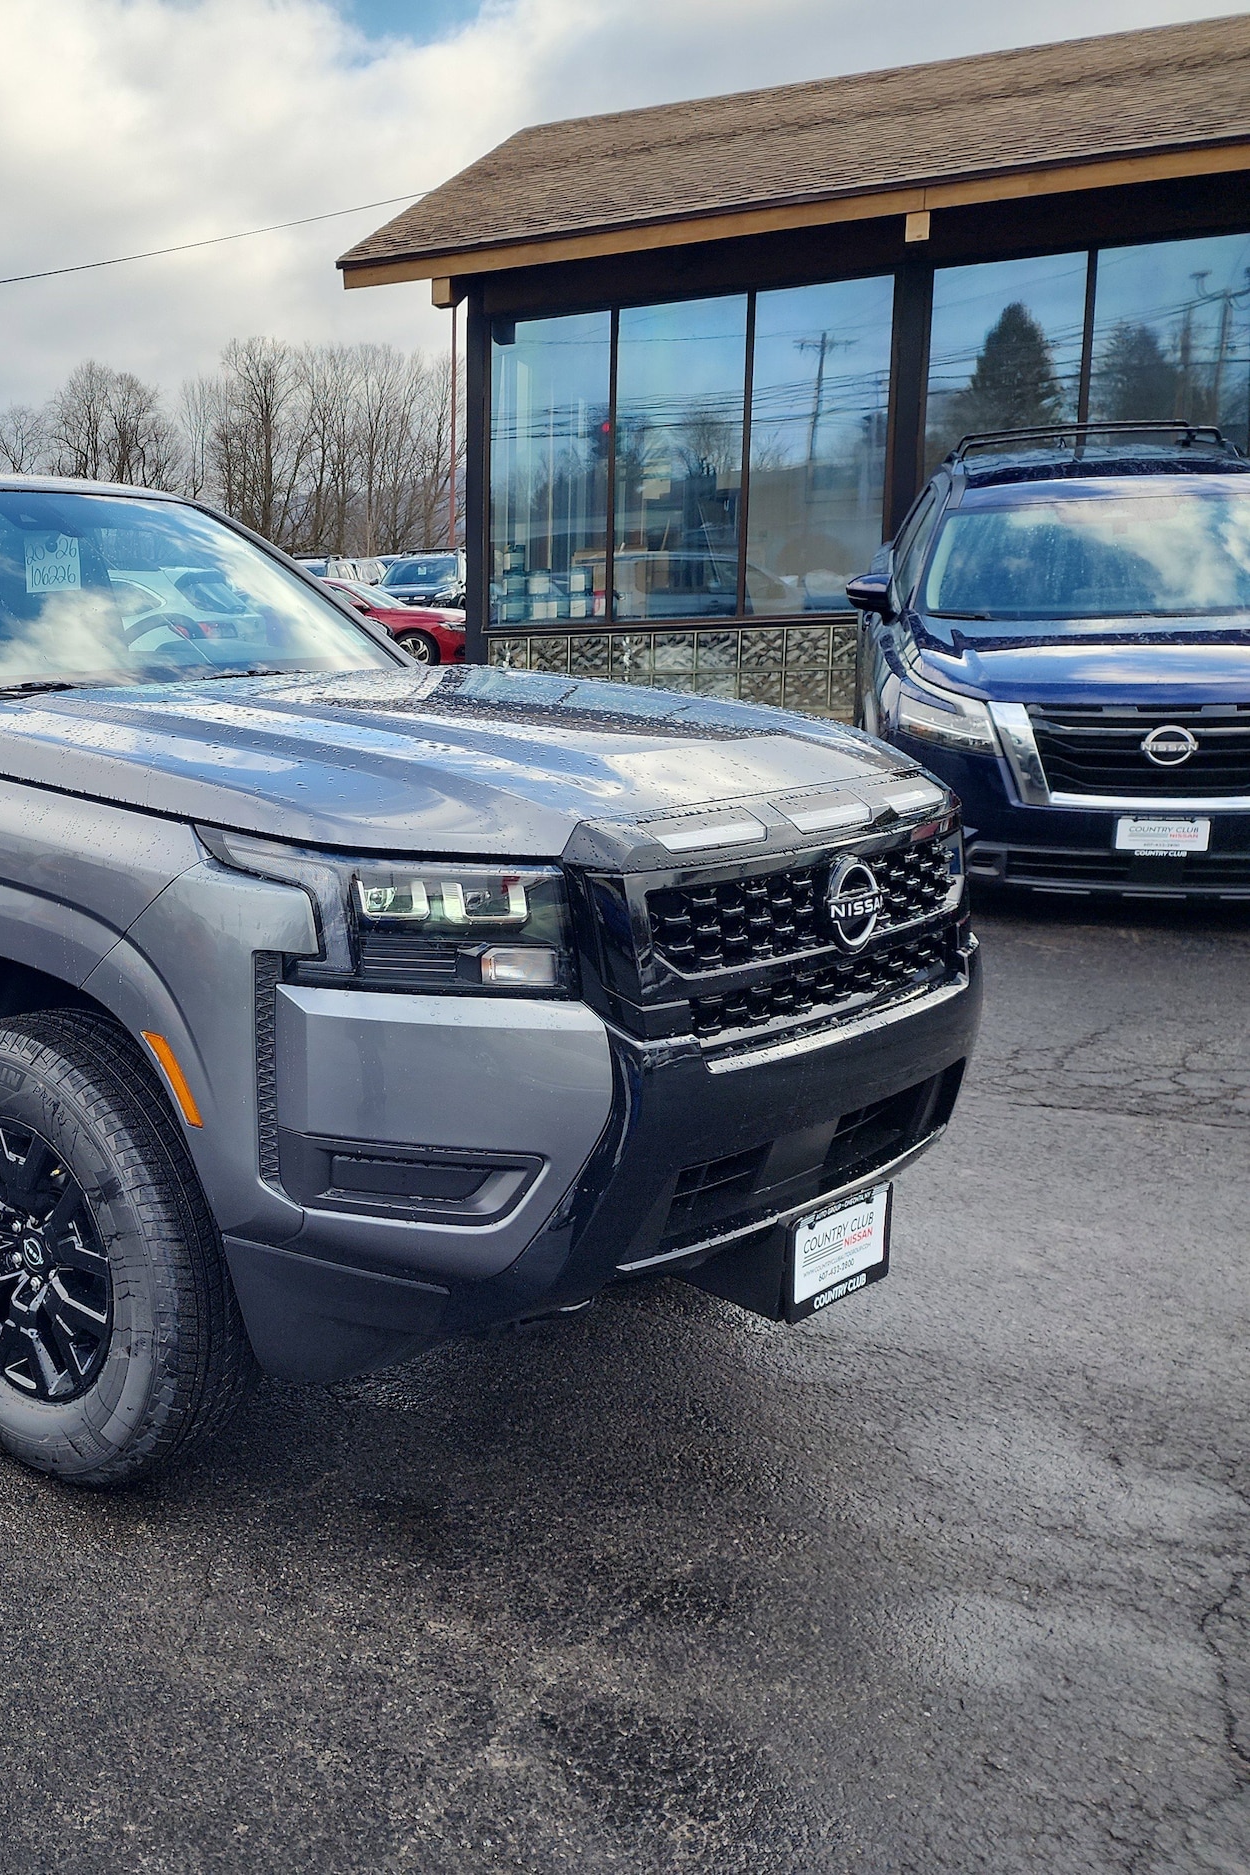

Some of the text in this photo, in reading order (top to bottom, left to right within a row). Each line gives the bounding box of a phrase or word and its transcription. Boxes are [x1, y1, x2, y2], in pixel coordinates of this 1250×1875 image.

[31, 564, 76, 588] 106226
[1142, 743, 1198, 751] NISSAN
[1168, 850, 1187, 858] CLUB
[830, 895, 884, 919] NISSA
[803, 1211, 874, 1254] COUNTRY CLUB
[844, 1227, 873, 1247] NISSAN
[818, 1258, 855, 1282] 607-432-2800
[813, 1272, 867, 1310] COUNTRY CLUB
